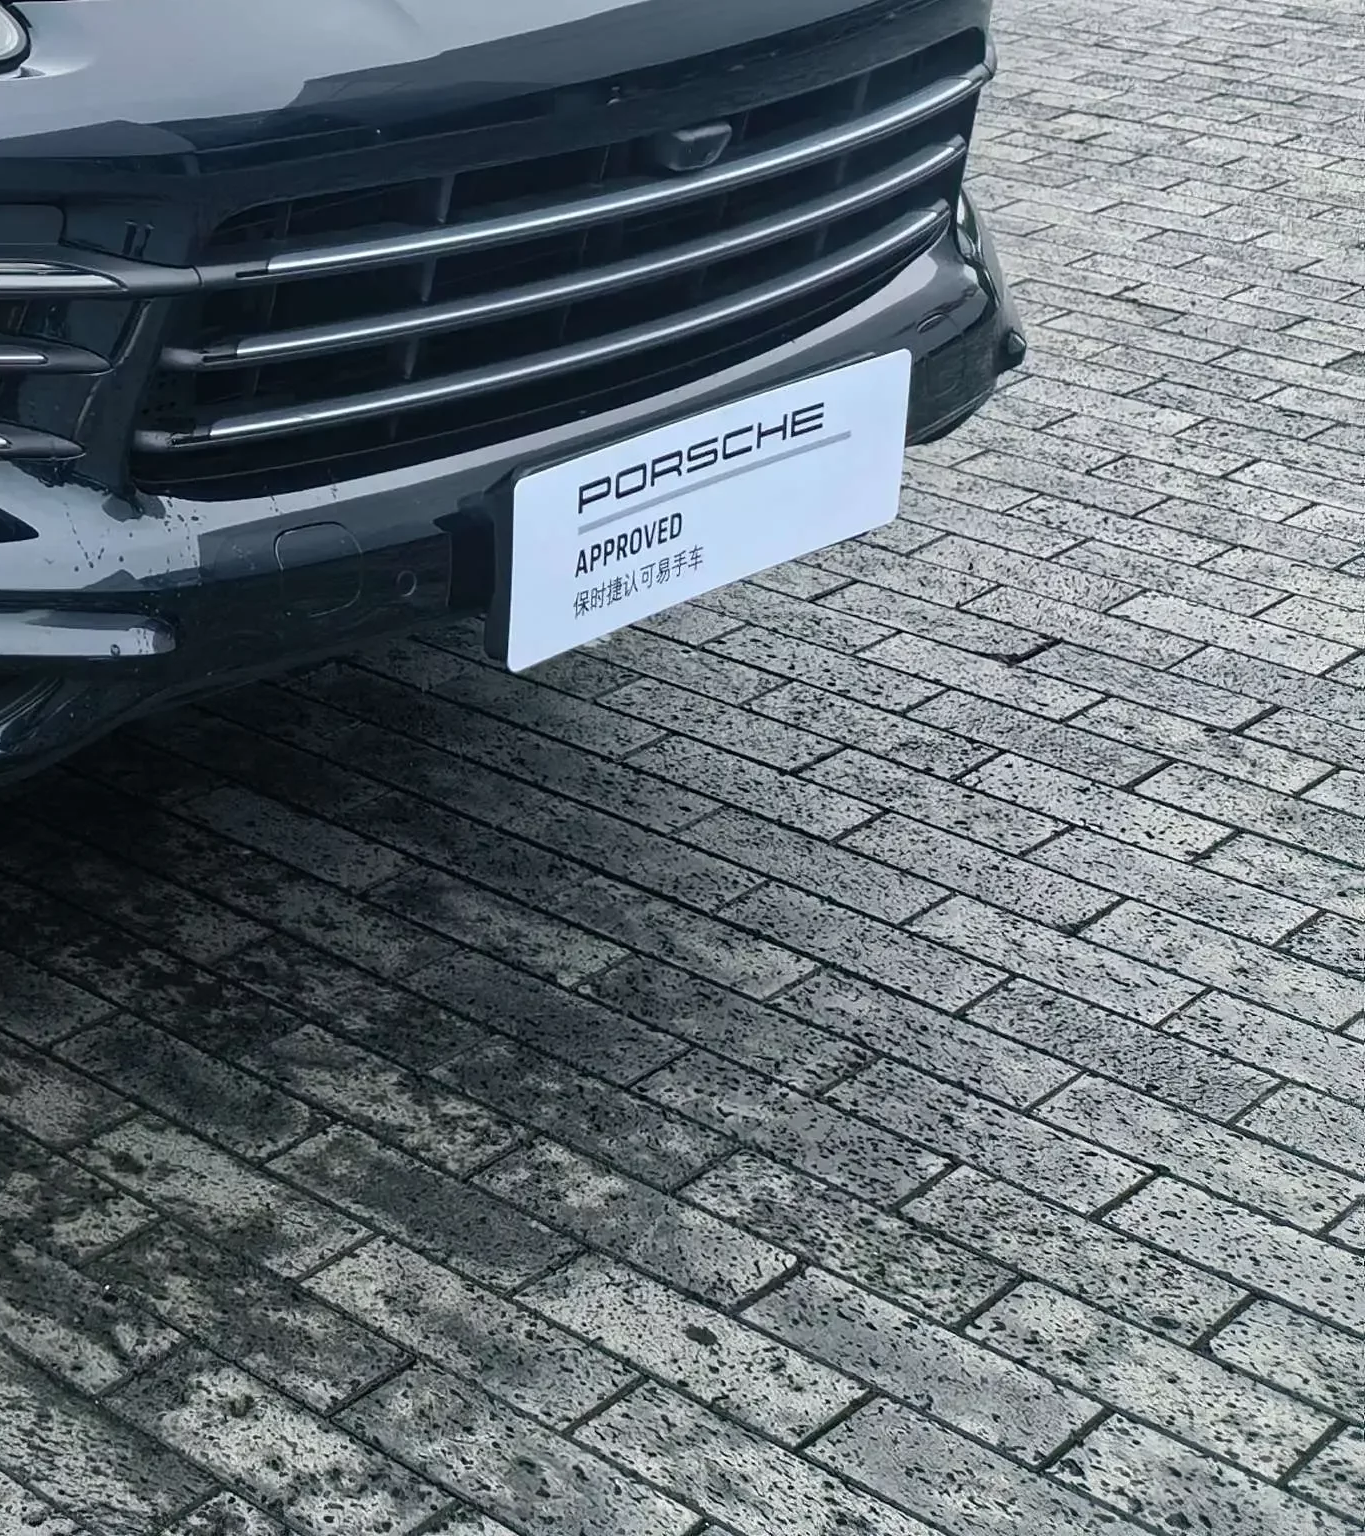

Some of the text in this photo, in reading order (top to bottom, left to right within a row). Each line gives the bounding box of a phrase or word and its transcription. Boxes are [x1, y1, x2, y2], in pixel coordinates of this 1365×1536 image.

[578, 402, 825, 514] PORSCHE
[573, 544, 704, 619] 保时捷认可易手车
[574, 512, 683, 578] APPROVED
